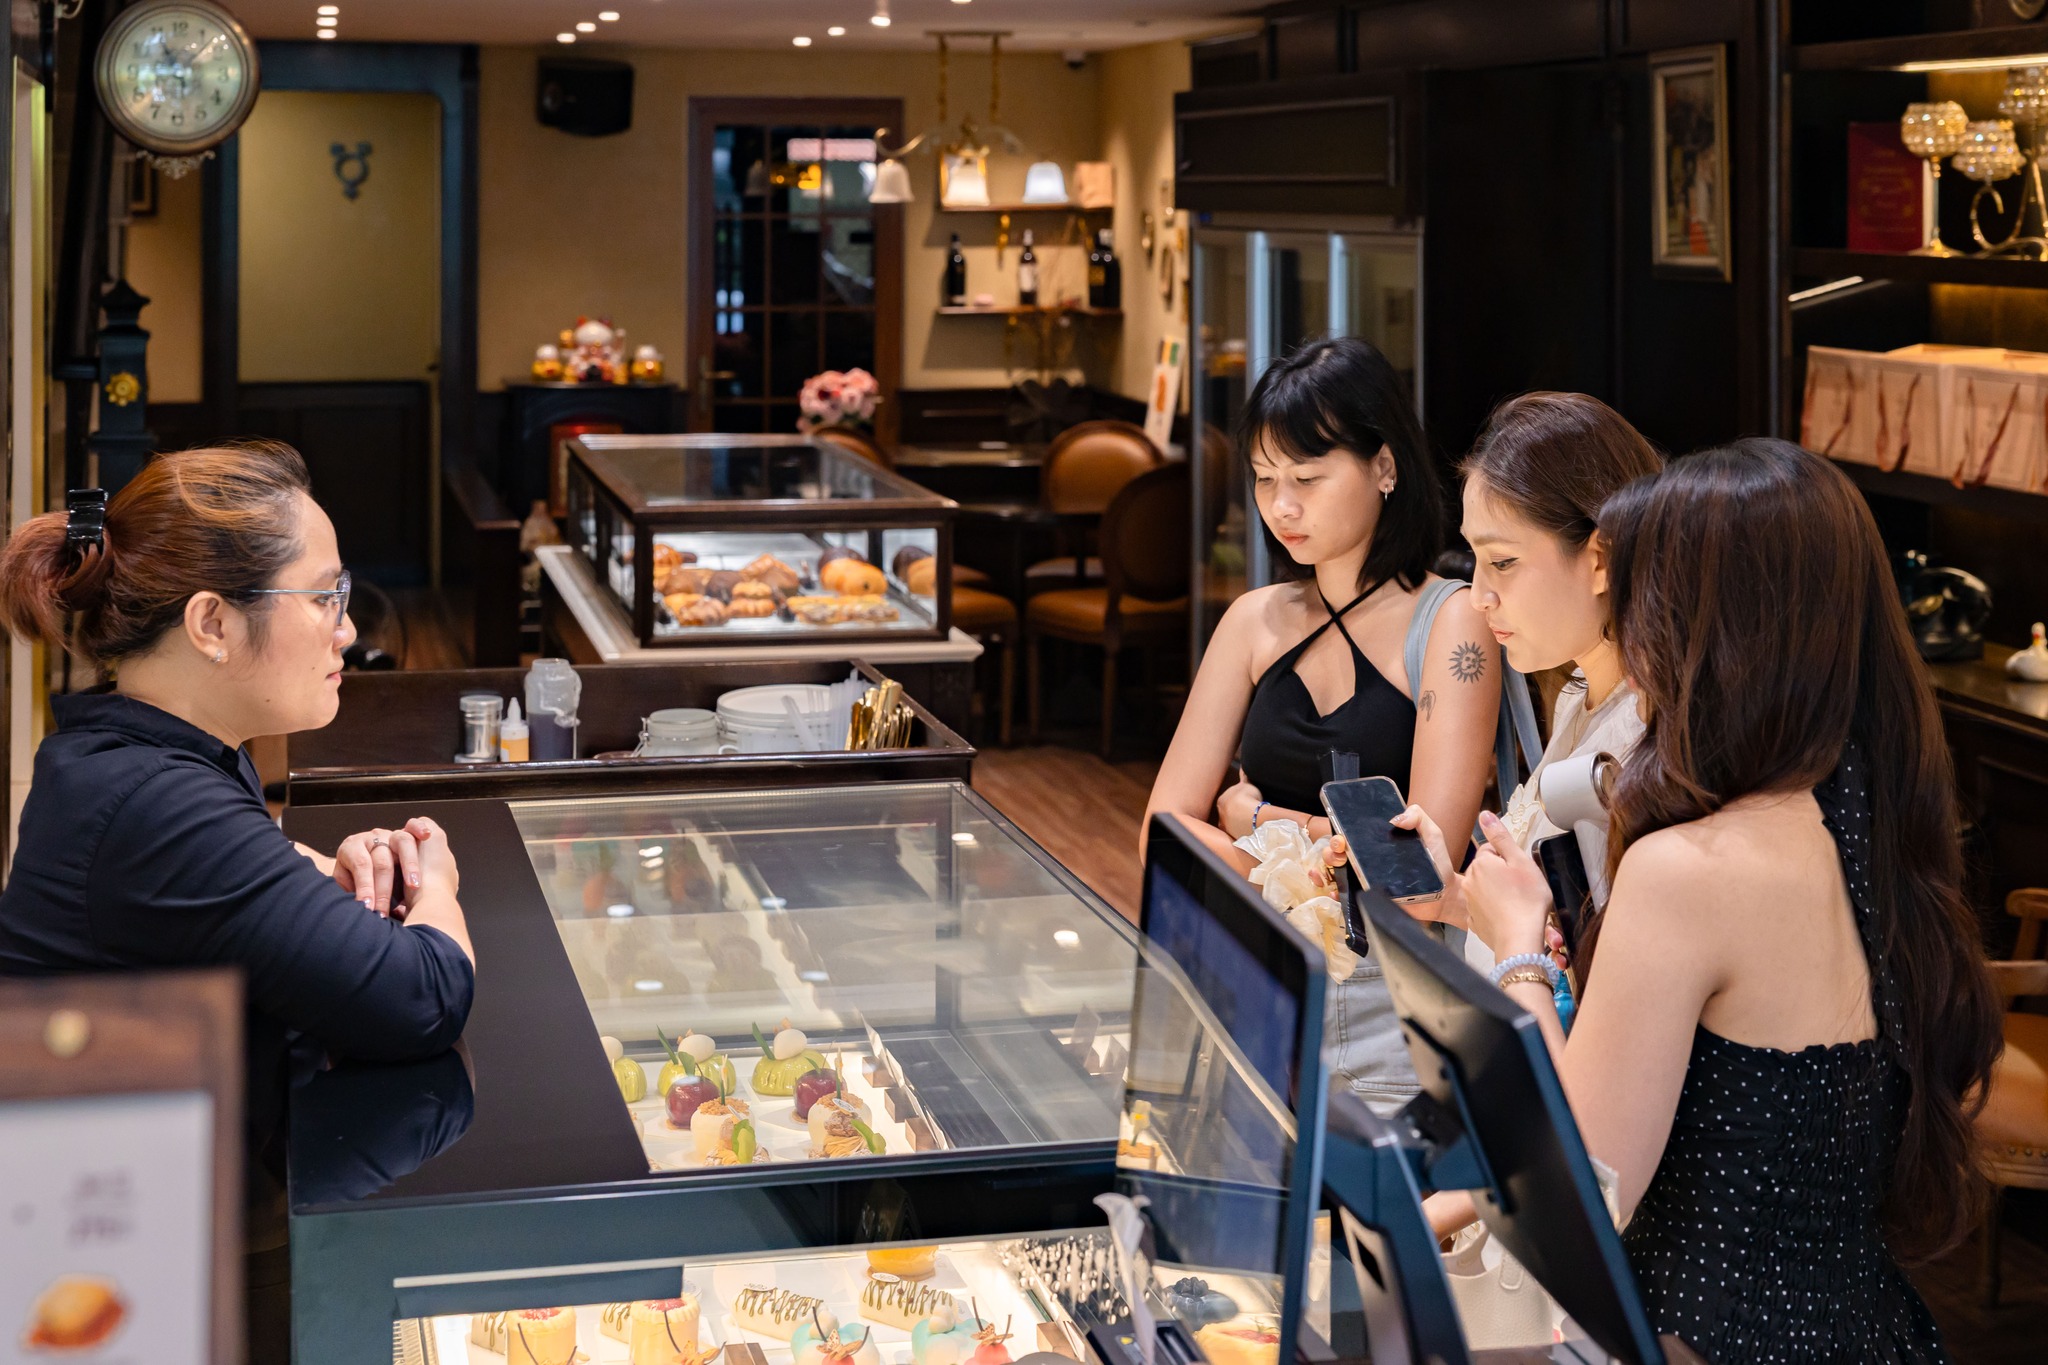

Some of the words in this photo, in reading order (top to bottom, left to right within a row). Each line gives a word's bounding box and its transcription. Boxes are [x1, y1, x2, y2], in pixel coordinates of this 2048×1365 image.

[173, 21, 189, 38] 12
[210, 88, 222, 105] 4
[151, 104, 162, 119] 7
